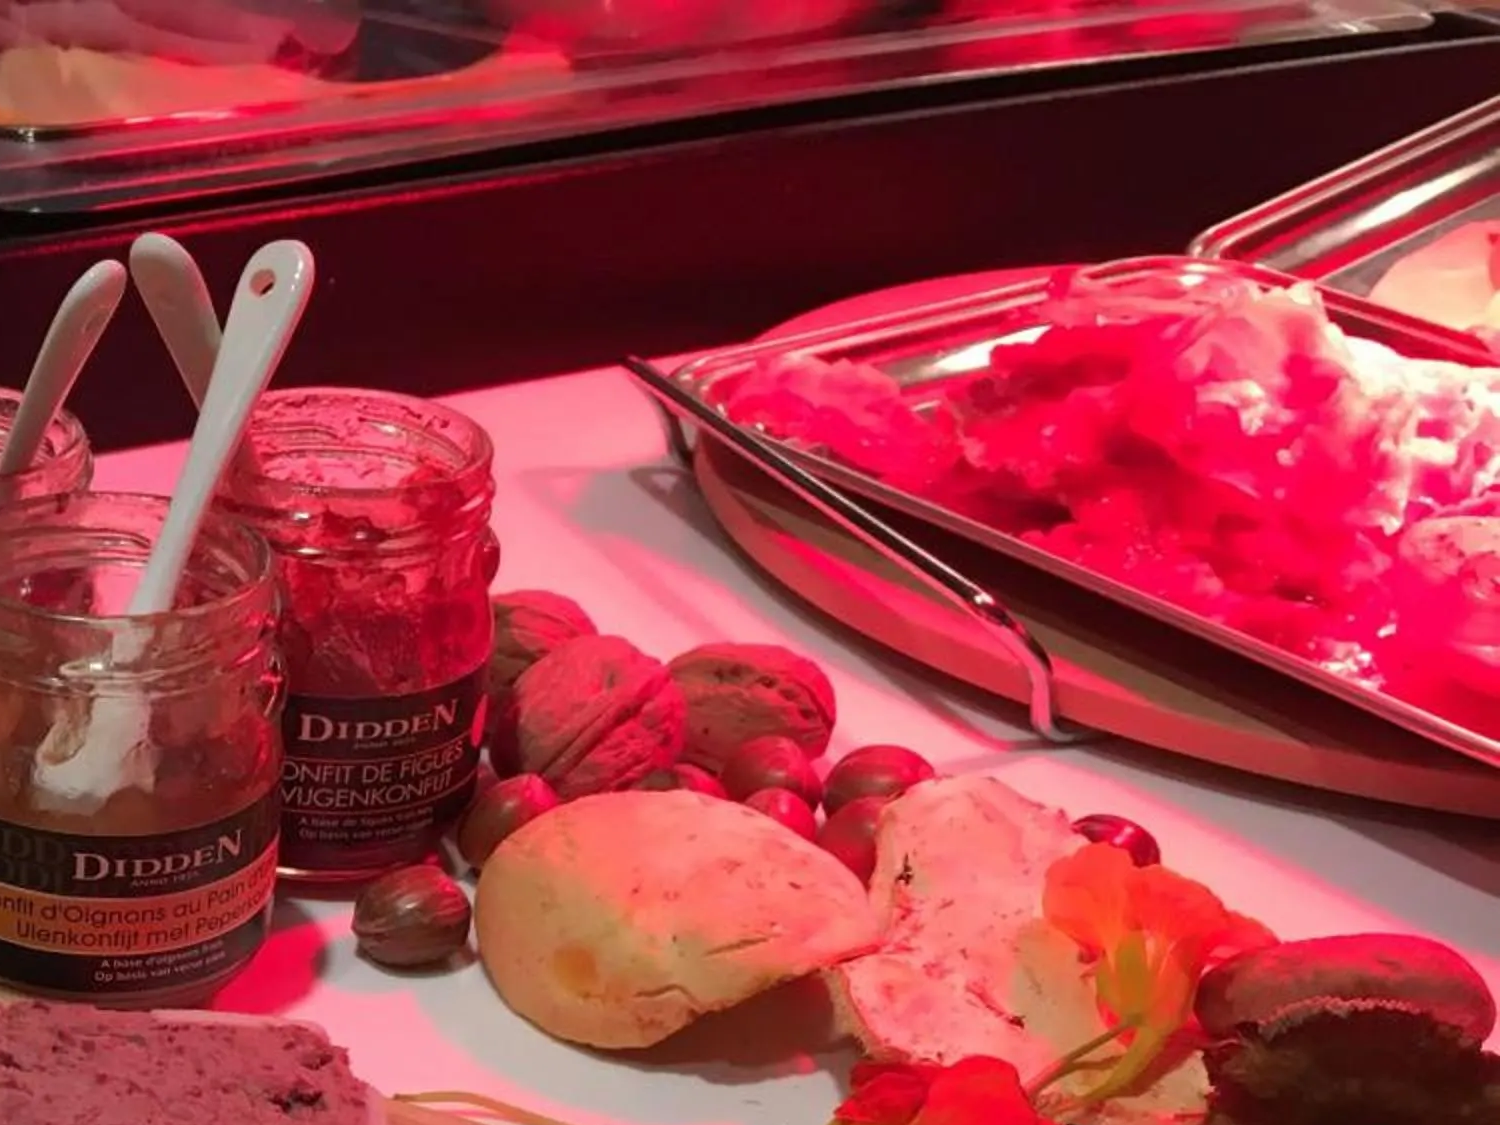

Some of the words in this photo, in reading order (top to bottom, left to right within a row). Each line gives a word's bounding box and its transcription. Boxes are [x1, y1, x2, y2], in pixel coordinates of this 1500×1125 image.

[298, 699, 458, 742] DIDDEN
[281, 760, 355, 785] ONFIT
[362, 764, 393, 783] DE
[400, 741, 464, 778] FIGUES
[280, 767, 454, 808] VIJGENKONFIJT
[72, 829, 244, 881] DIDDEN
[41, 901, 167, 929] d'Oignons
[174, 897, 200, 918] au
[208, 882, 245, 910] Pain
[16, 919, 139, 950] Uienkonfijt
[146, 923, 190, 946] met
